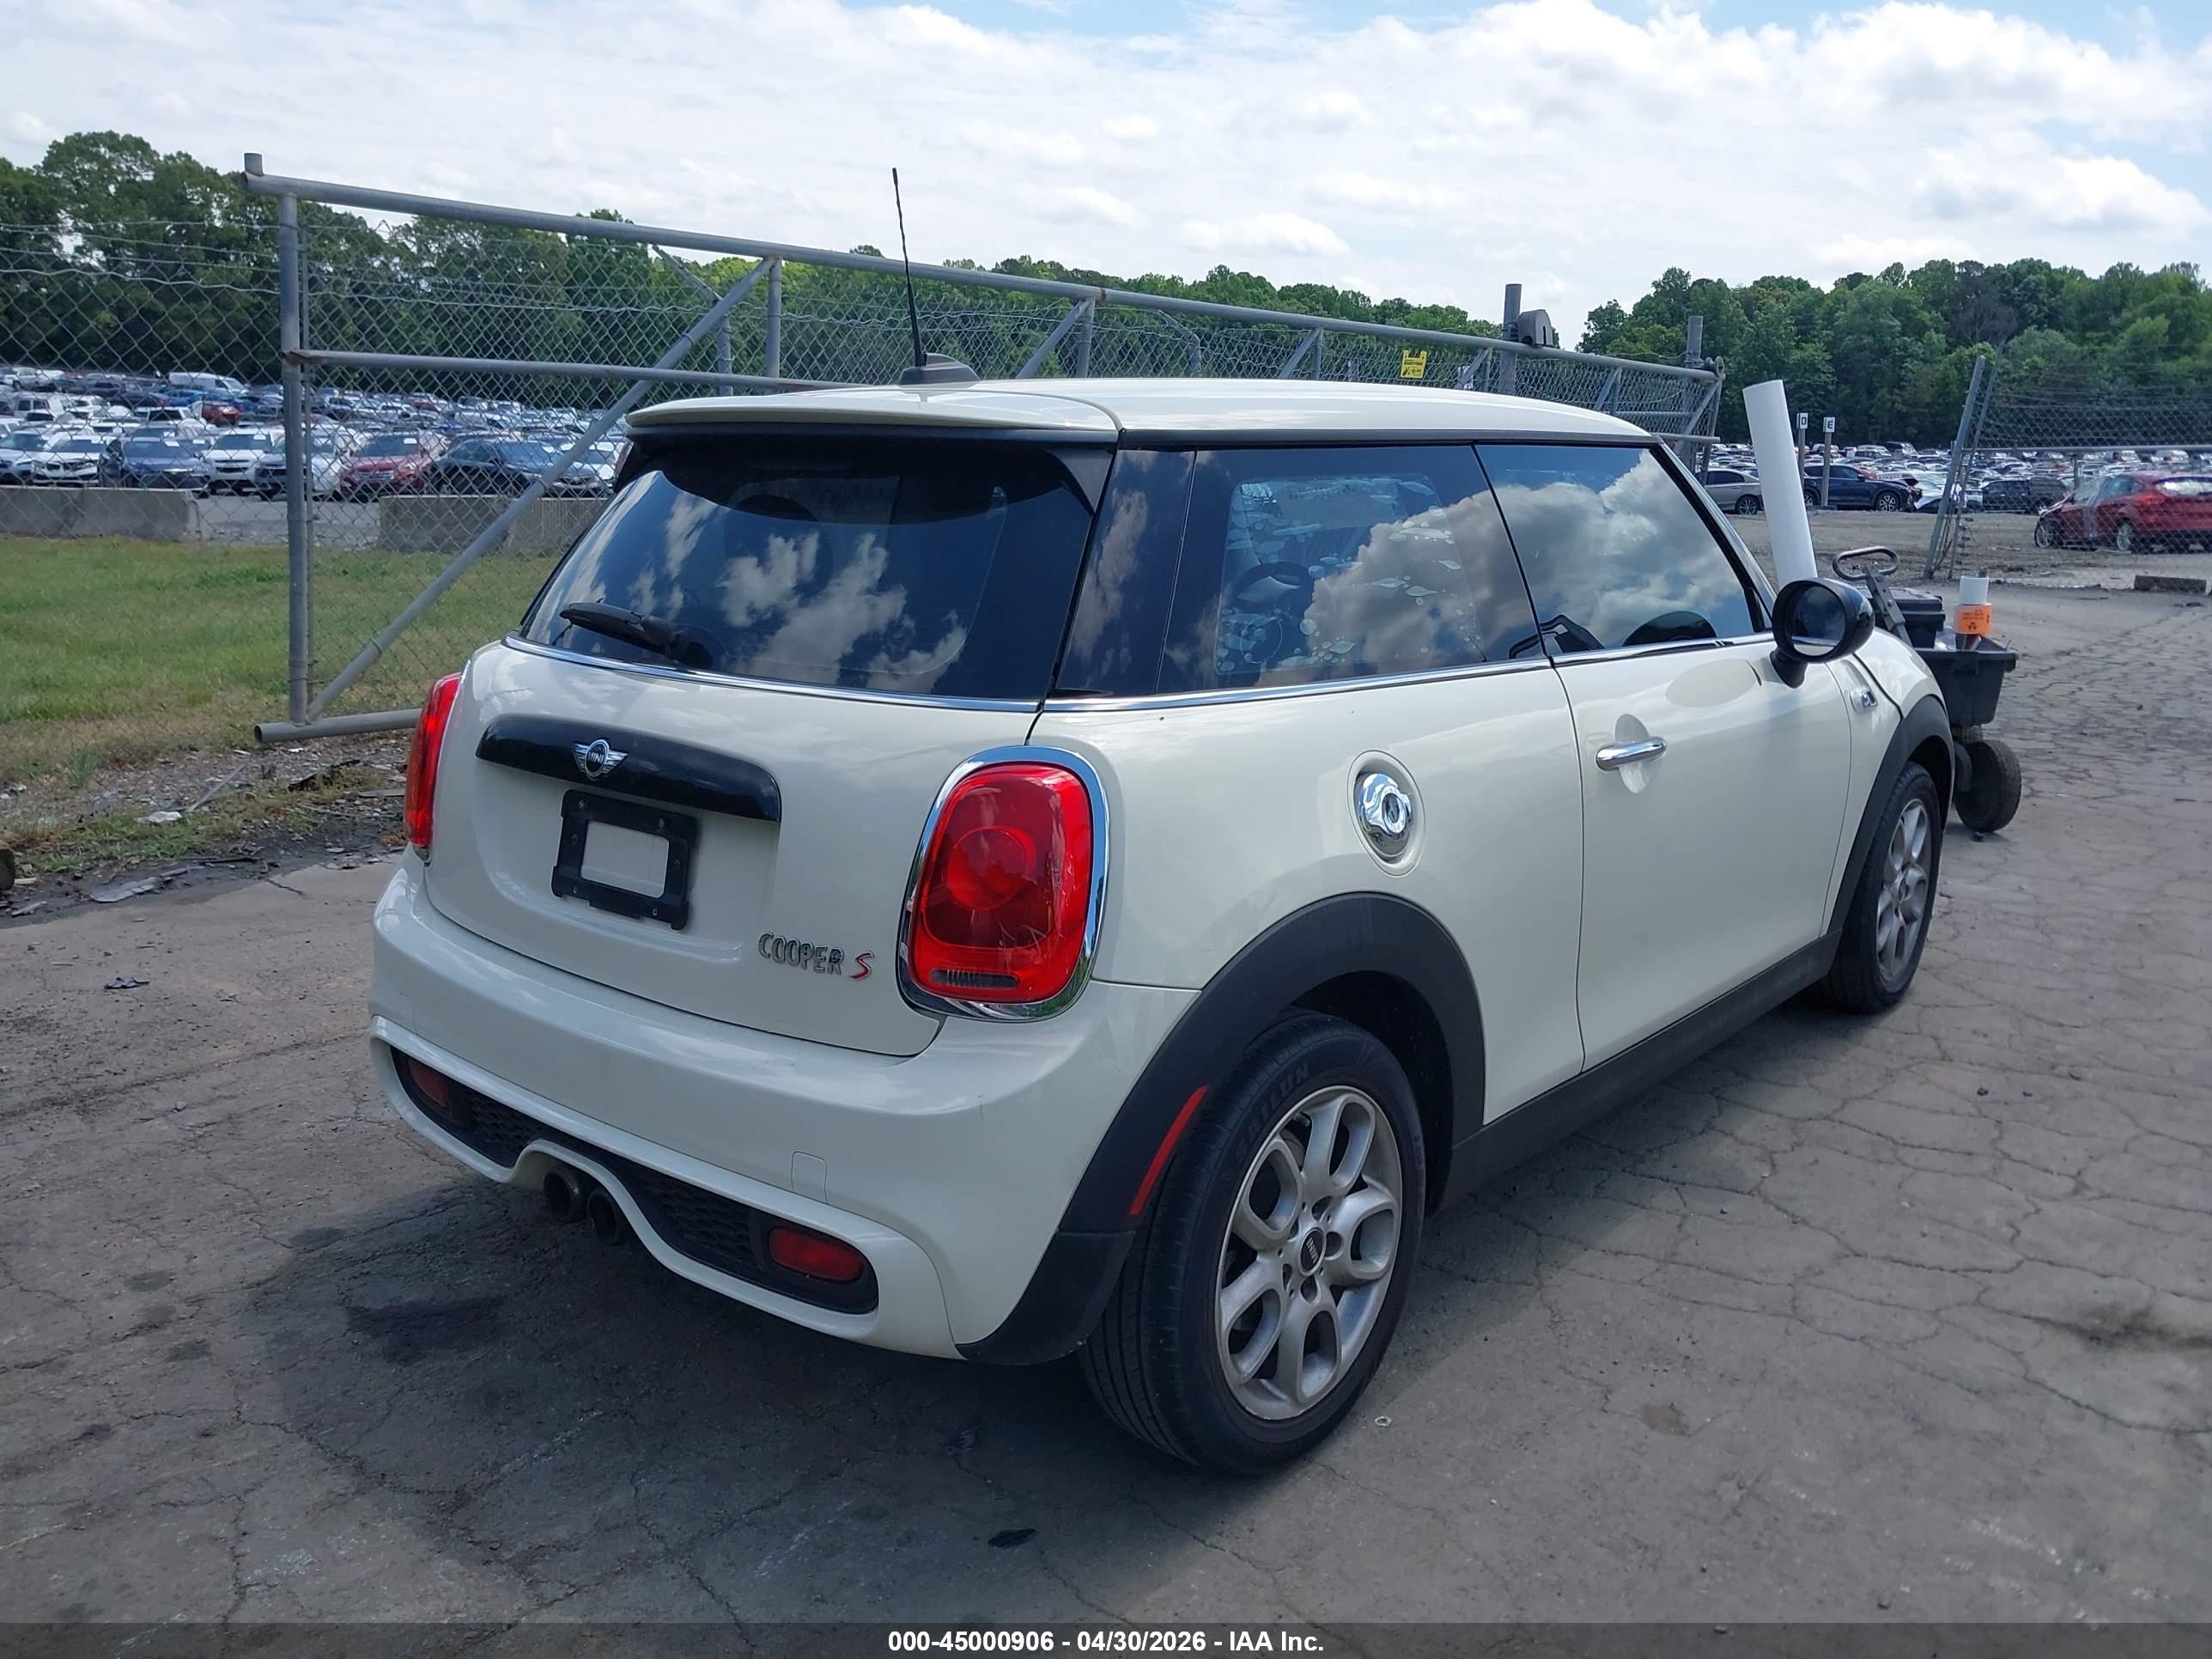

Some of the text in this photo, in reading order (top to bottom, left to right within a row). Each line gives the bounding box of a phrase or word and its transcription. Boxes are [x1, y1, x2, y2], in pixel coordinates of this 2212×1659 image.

[587, 751, 604, 763] MINI
[758, 932, 875, 981] COOPER S
[1305, 1237, 1319, 1265] MINI
